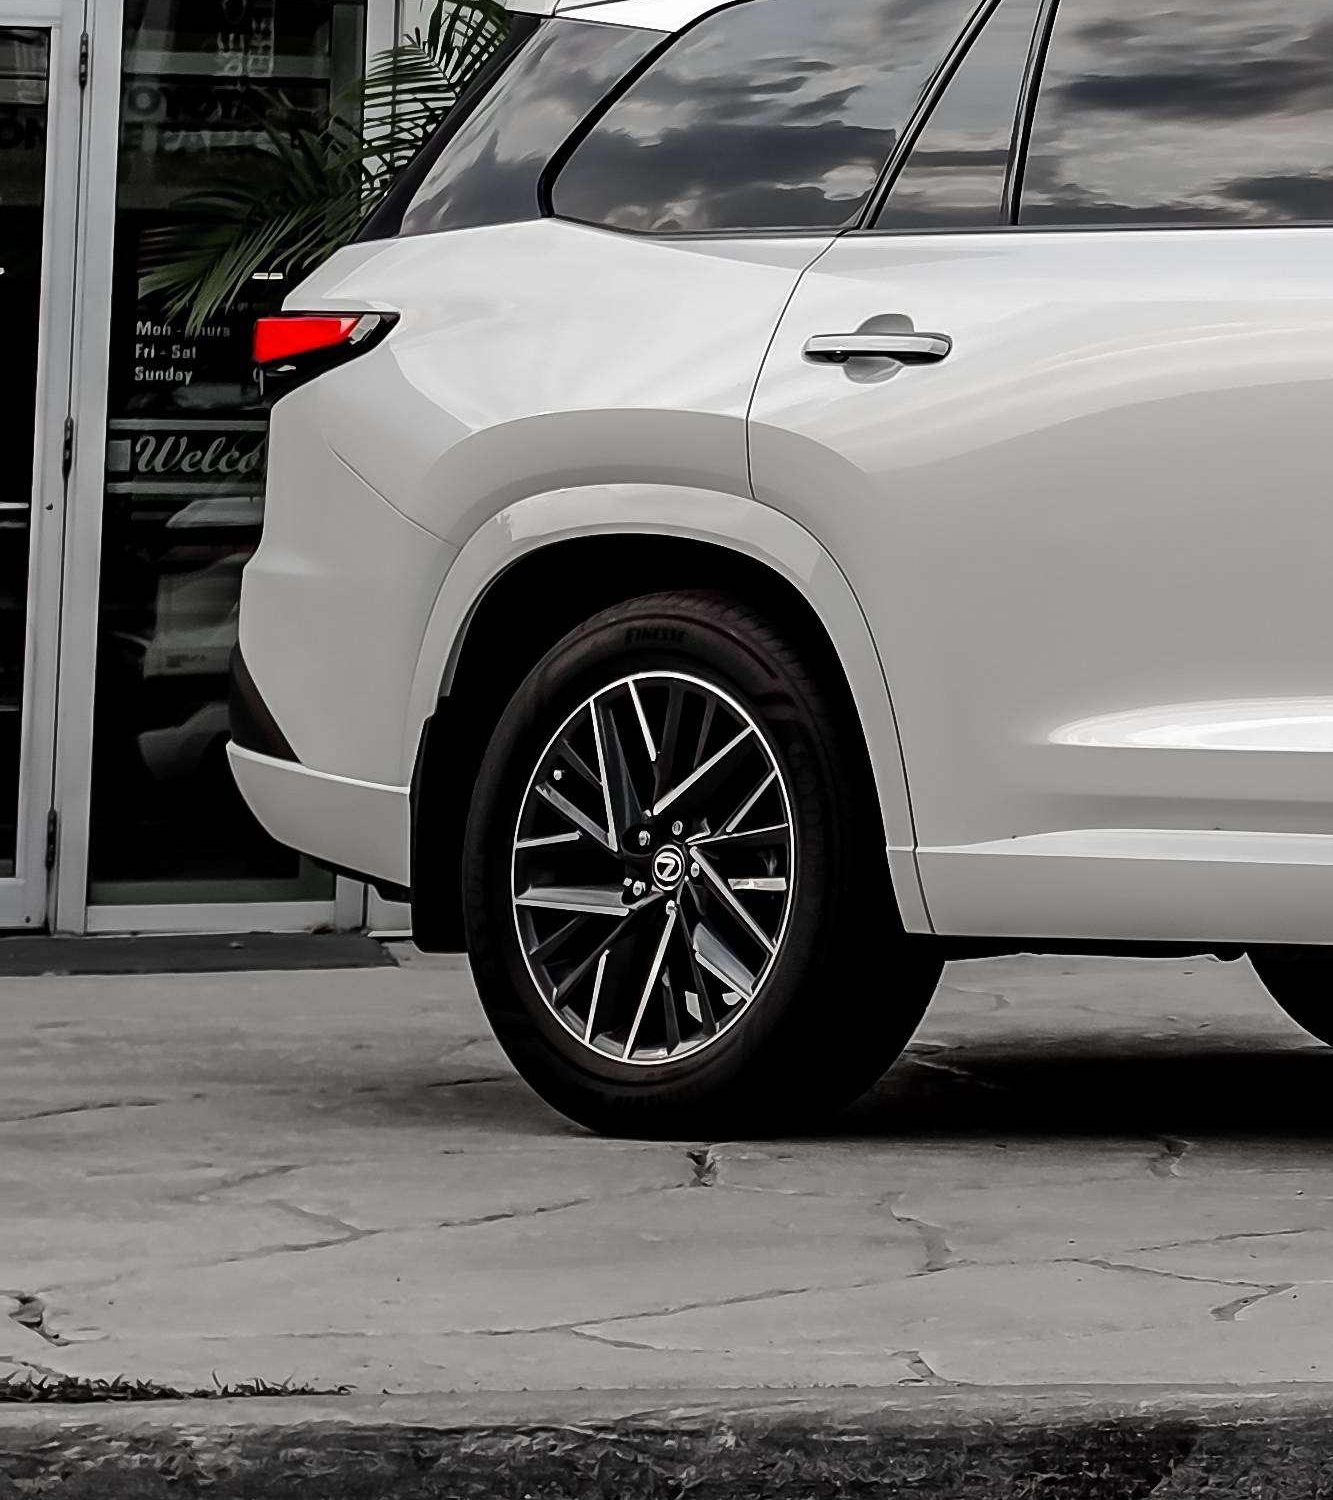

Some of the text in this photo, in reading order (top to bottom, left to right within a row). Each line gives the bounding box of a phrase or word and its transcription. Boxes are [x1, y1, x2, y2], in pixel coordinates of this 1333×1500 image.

[135, 320, 172, 337] Mon
[135, 342, 155, 359] Fri
[171, 344, 197, 360] Sat
[134, 365, 193, 386] Sunday
